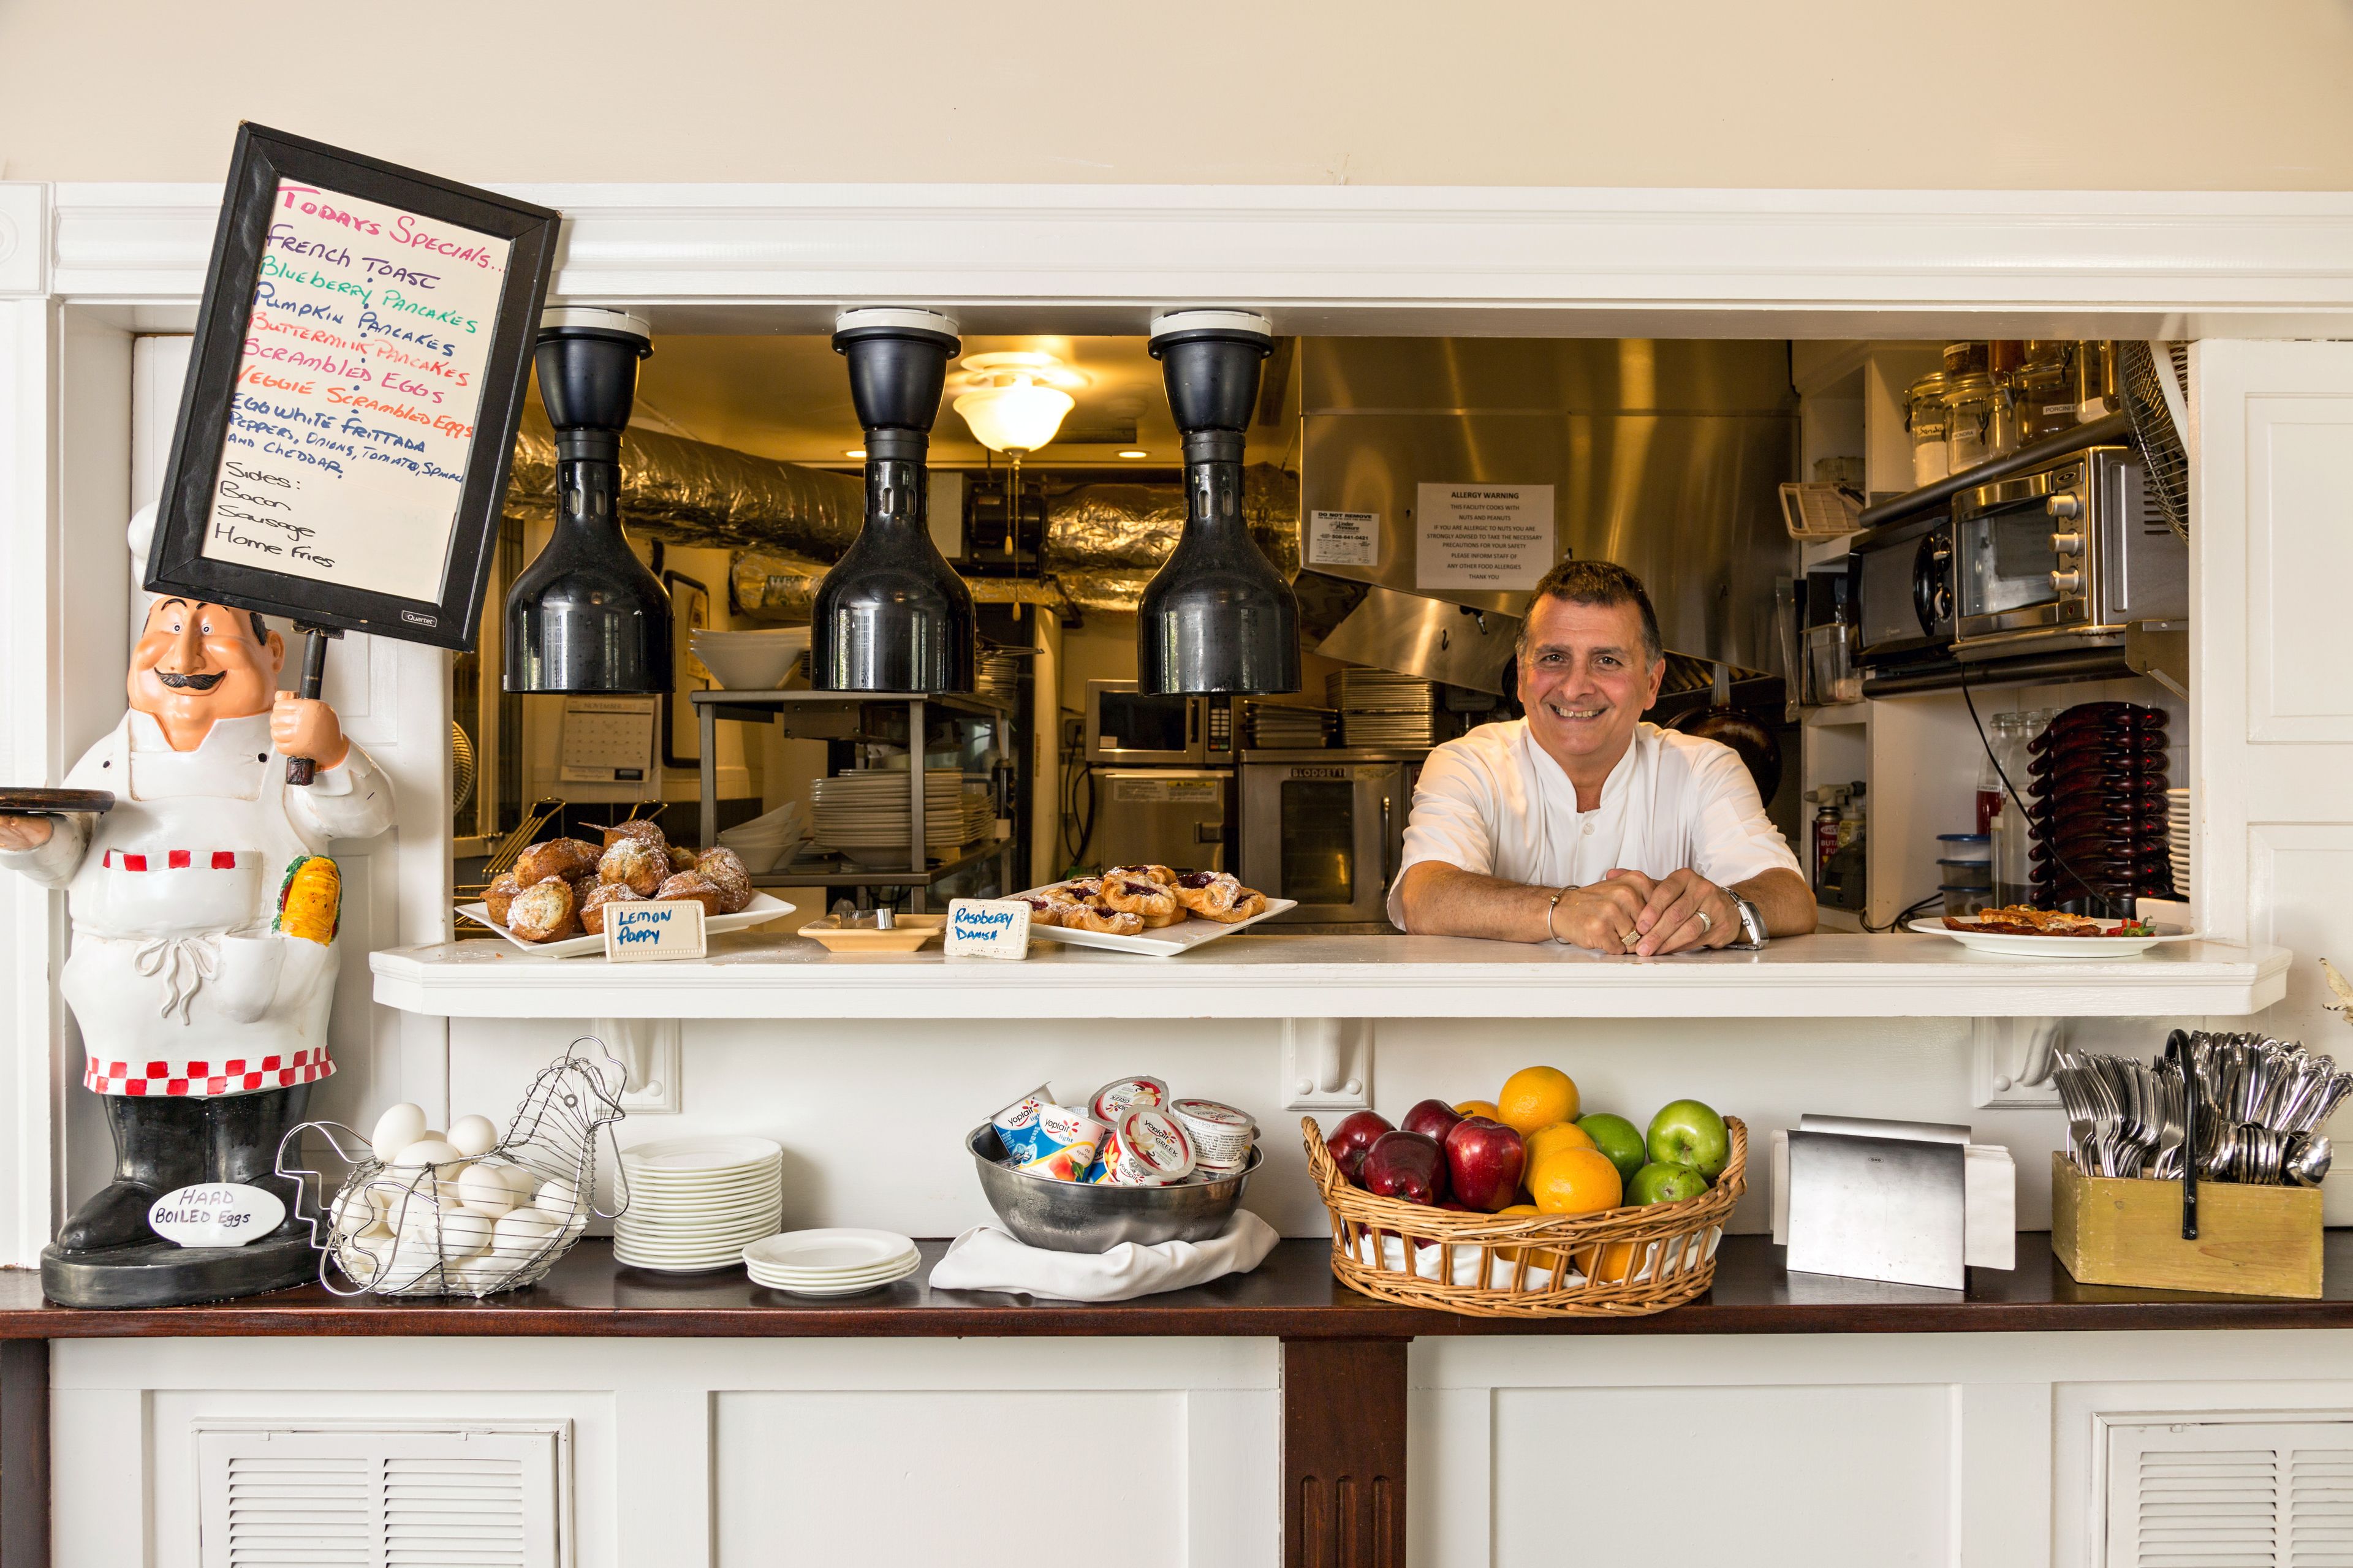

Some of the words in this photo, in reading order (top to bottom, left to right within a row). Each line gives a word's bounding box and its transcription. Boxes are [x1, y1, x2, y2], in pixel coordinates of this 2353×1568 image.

[362, 257, 440, 289] TOAST
[382, 290, 478, 333] PANCAKES
[358, 312, 455, 357] PANCAKES
[376, 339, 471, 386] PANCAKES
[237, 365, 315, 395] VEGGIE
[382, 373, 445, 404] EGGS
[230, 393, 275, 414] EGG
[227, 433, 254, 447] AND
[221, 481, 292, 510] Bacon
[218, 505, 315, 541] Sausage
[215, 523, 282, 555] Home
[407, 615, 432, 624] Quartet
[618, 909, 672, 925] LEMON
[1008, 1107, 1033, 1127] yoplait
[1030, 1113, 1040, 1121] ligh
[1045, 1118, 1070, 1132] yoplait
[1059, 1134, 1074, 1143] light
[1144, 1119, 1169, 1140] yoplait
[1156, 1137, 1178, 1157] GREEK
[1119, 1161, 1137, 1181] yoplait
[179, 1189, 233, 1205] HARD
[155, 1207, 210, 1223] BOILED
[219, 1210, 251, 1227] Eggs
